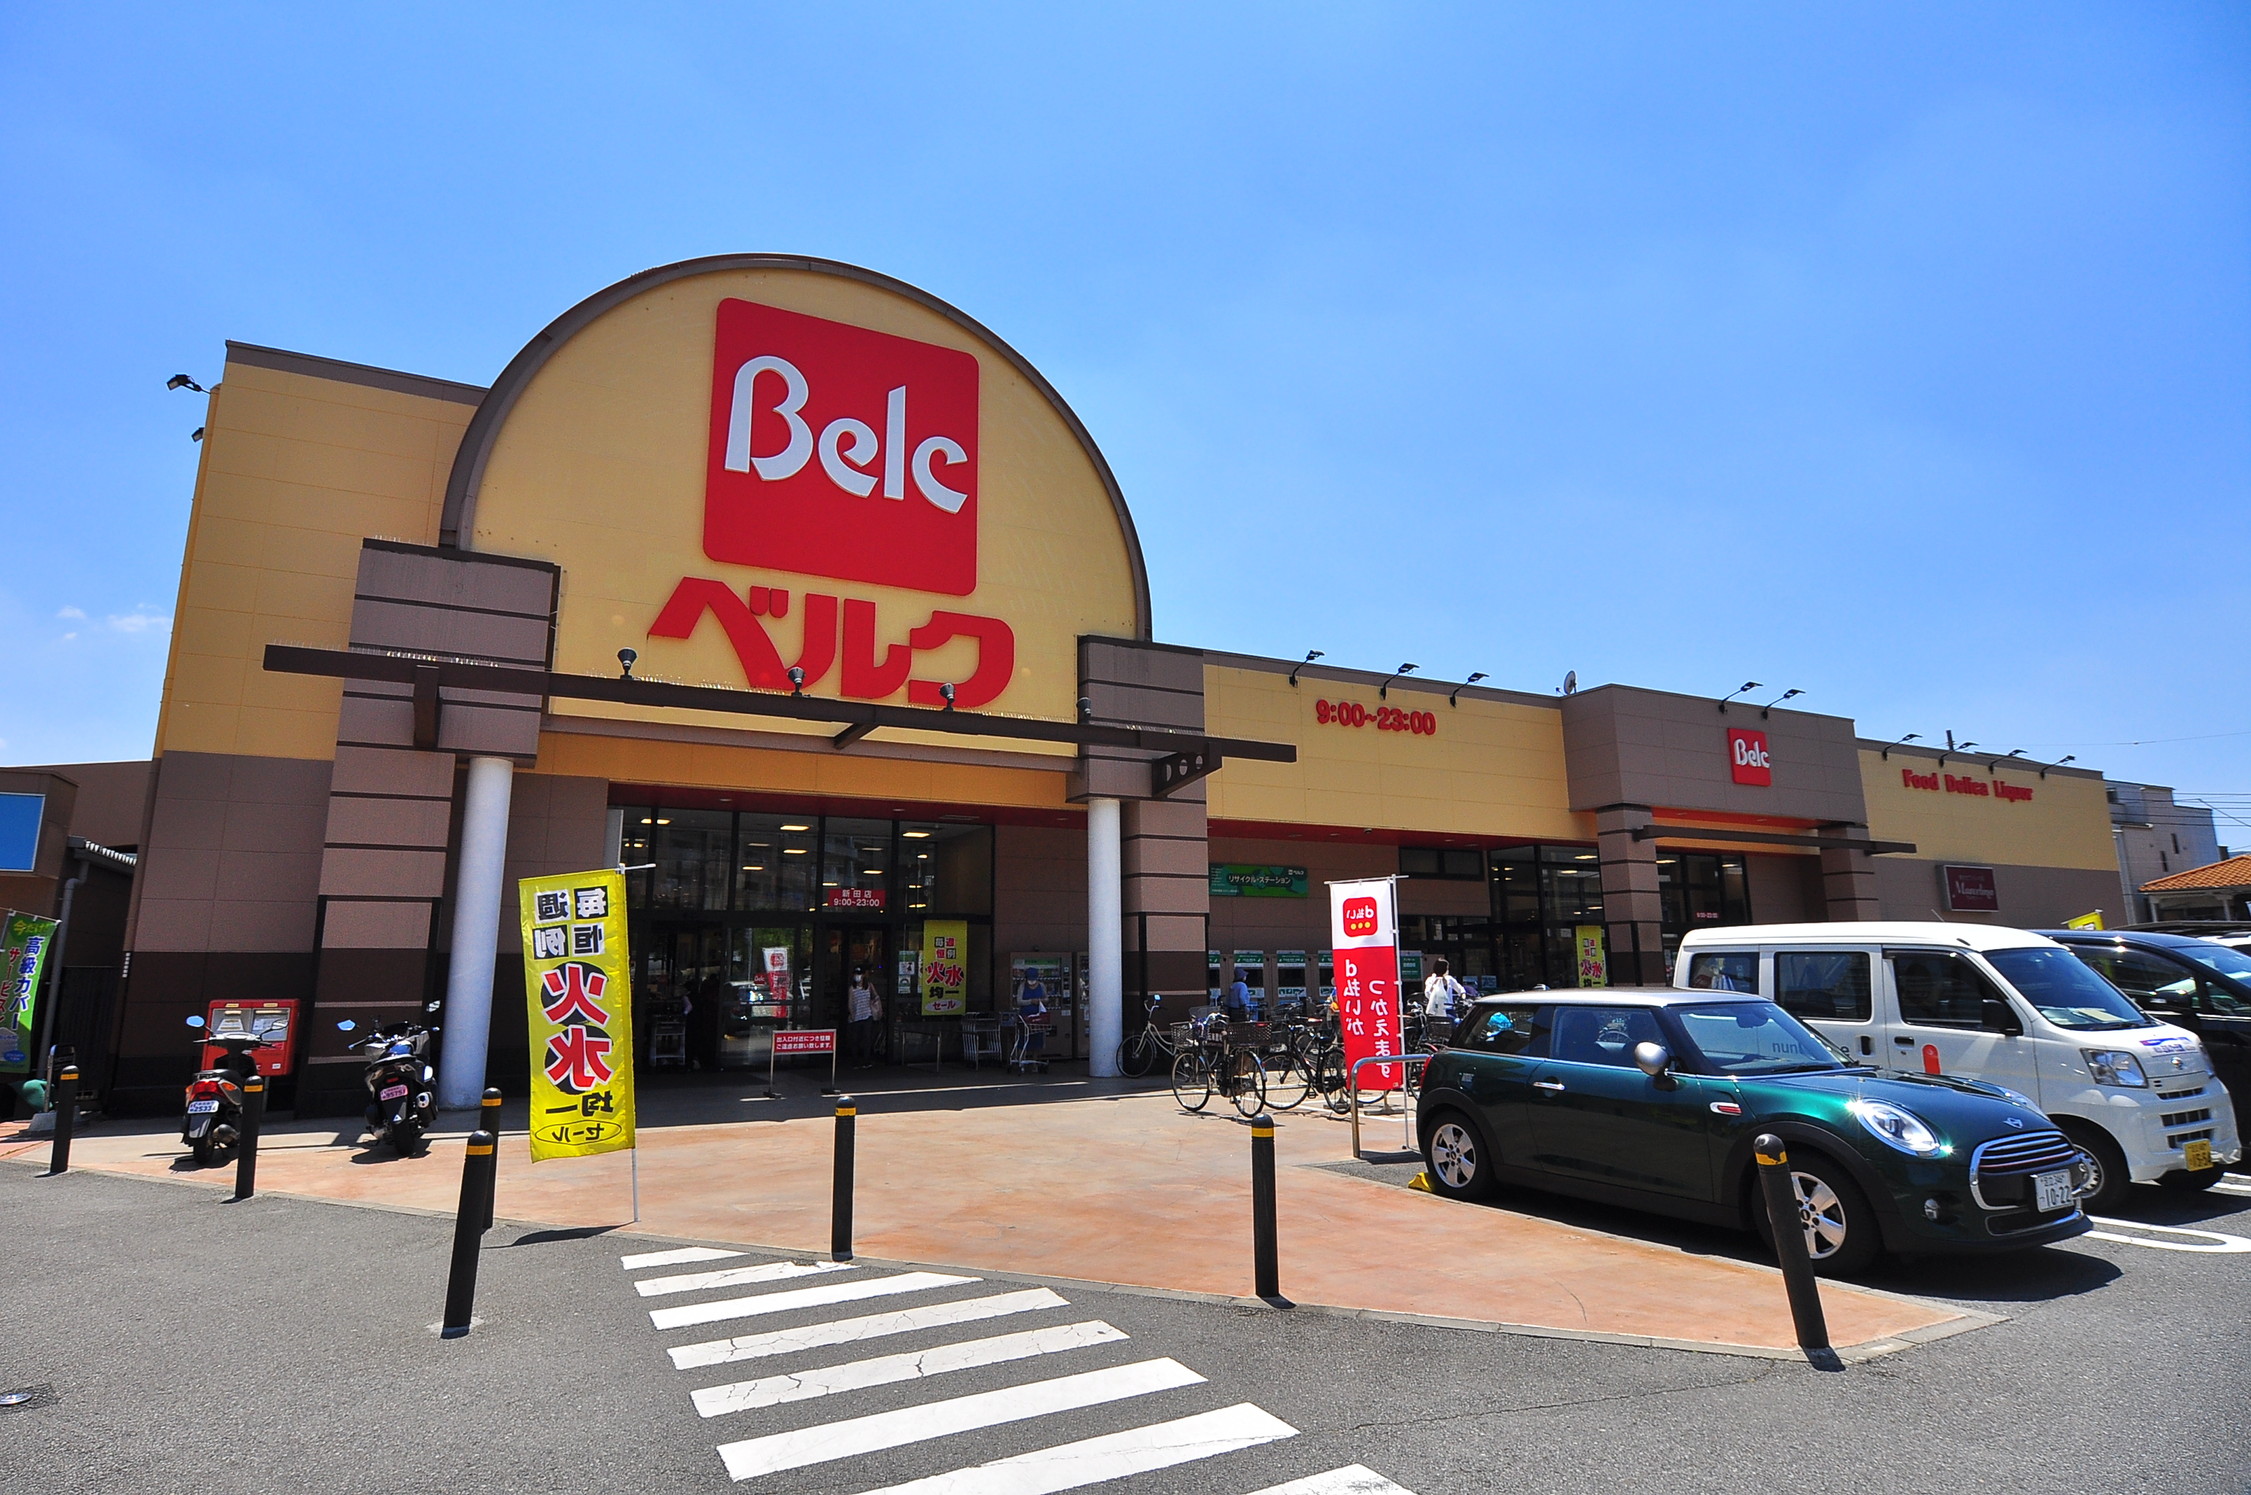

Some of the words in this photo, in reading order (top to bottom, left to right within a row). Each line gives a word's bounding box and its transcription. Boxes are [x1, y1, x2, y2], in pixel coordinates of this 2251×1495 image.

[724, 355, 969, 515] Belc
[647, 576, 1015, 709] ベルク
[1734, 738, 1770, 769] Belc
[1902, 769, 1940, 791] Food
[1944, 774, 1990, 797] Delica
[1992, 780, 2034, 803] Liquor
[842, 889, 872, 899] 新田店
[9, 936, 45, 1030] 高級カバー
[926, 961, 964, 987] 火水
[932, 1000, 957, 1010] セール
